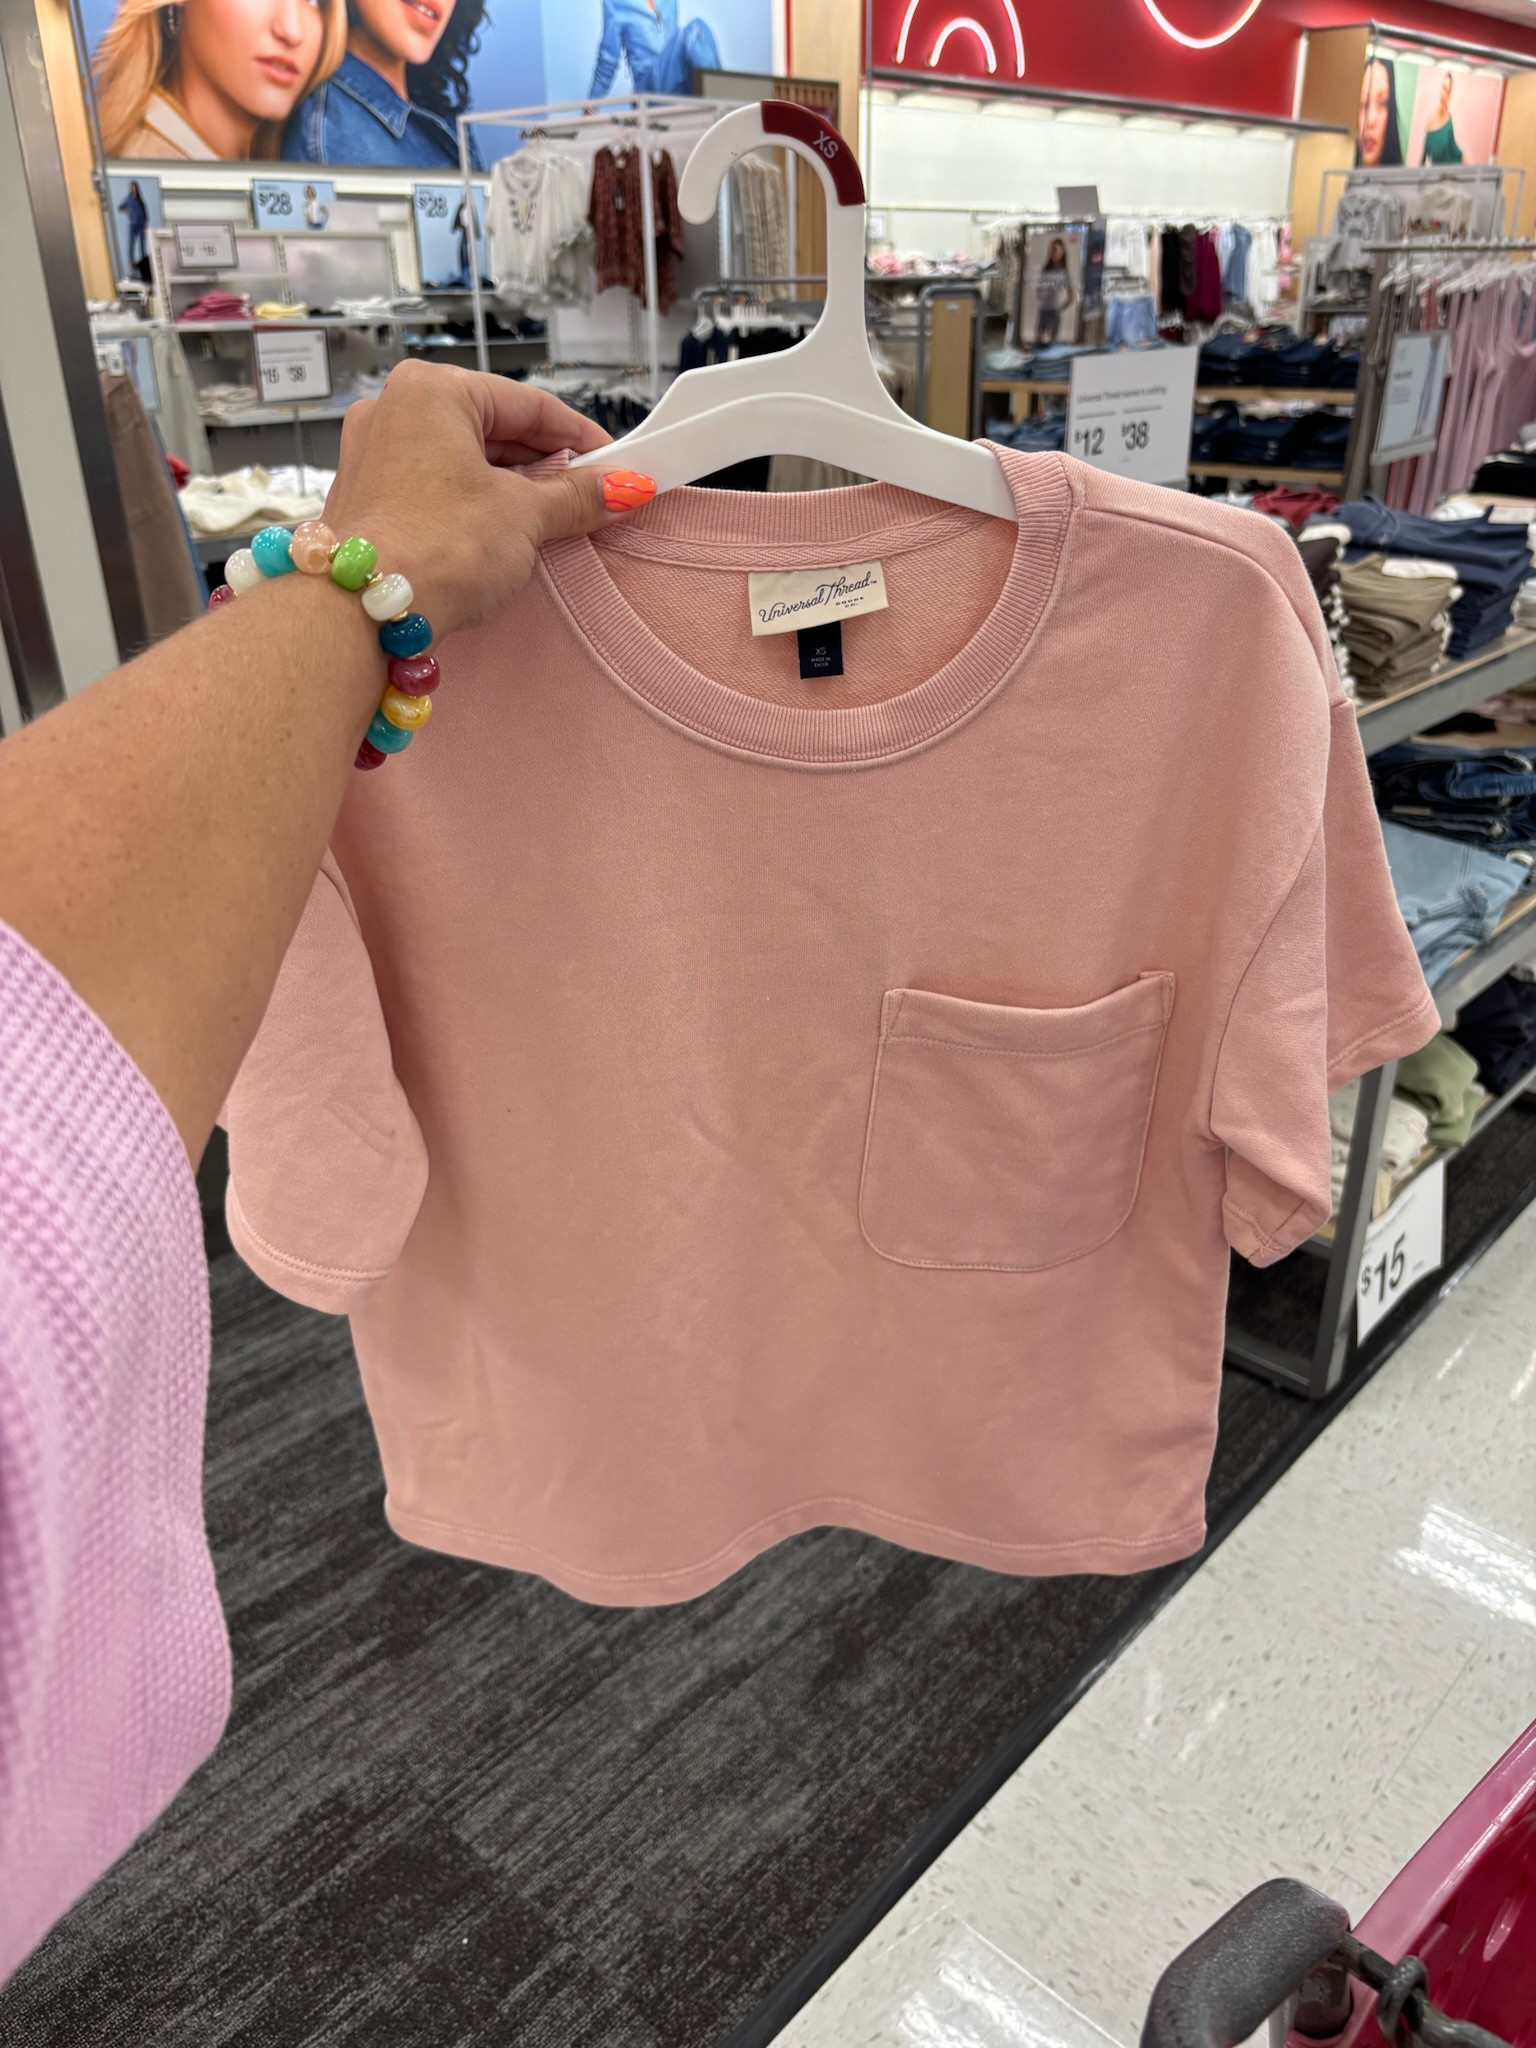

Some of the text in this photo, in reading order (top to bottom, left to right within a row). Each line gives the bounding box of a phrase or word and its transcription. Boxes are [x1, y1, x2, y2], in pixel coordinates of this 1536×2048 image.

[812, 130, 839, 159] XS
[259, 191, 293, 215] $28
[1074, 420, 1150, 457] $12 $38
[758, 588, 825, 623] Universal
[815, 646, 827, 656] XS
[1361, 1231, 1405, 1302] $15
